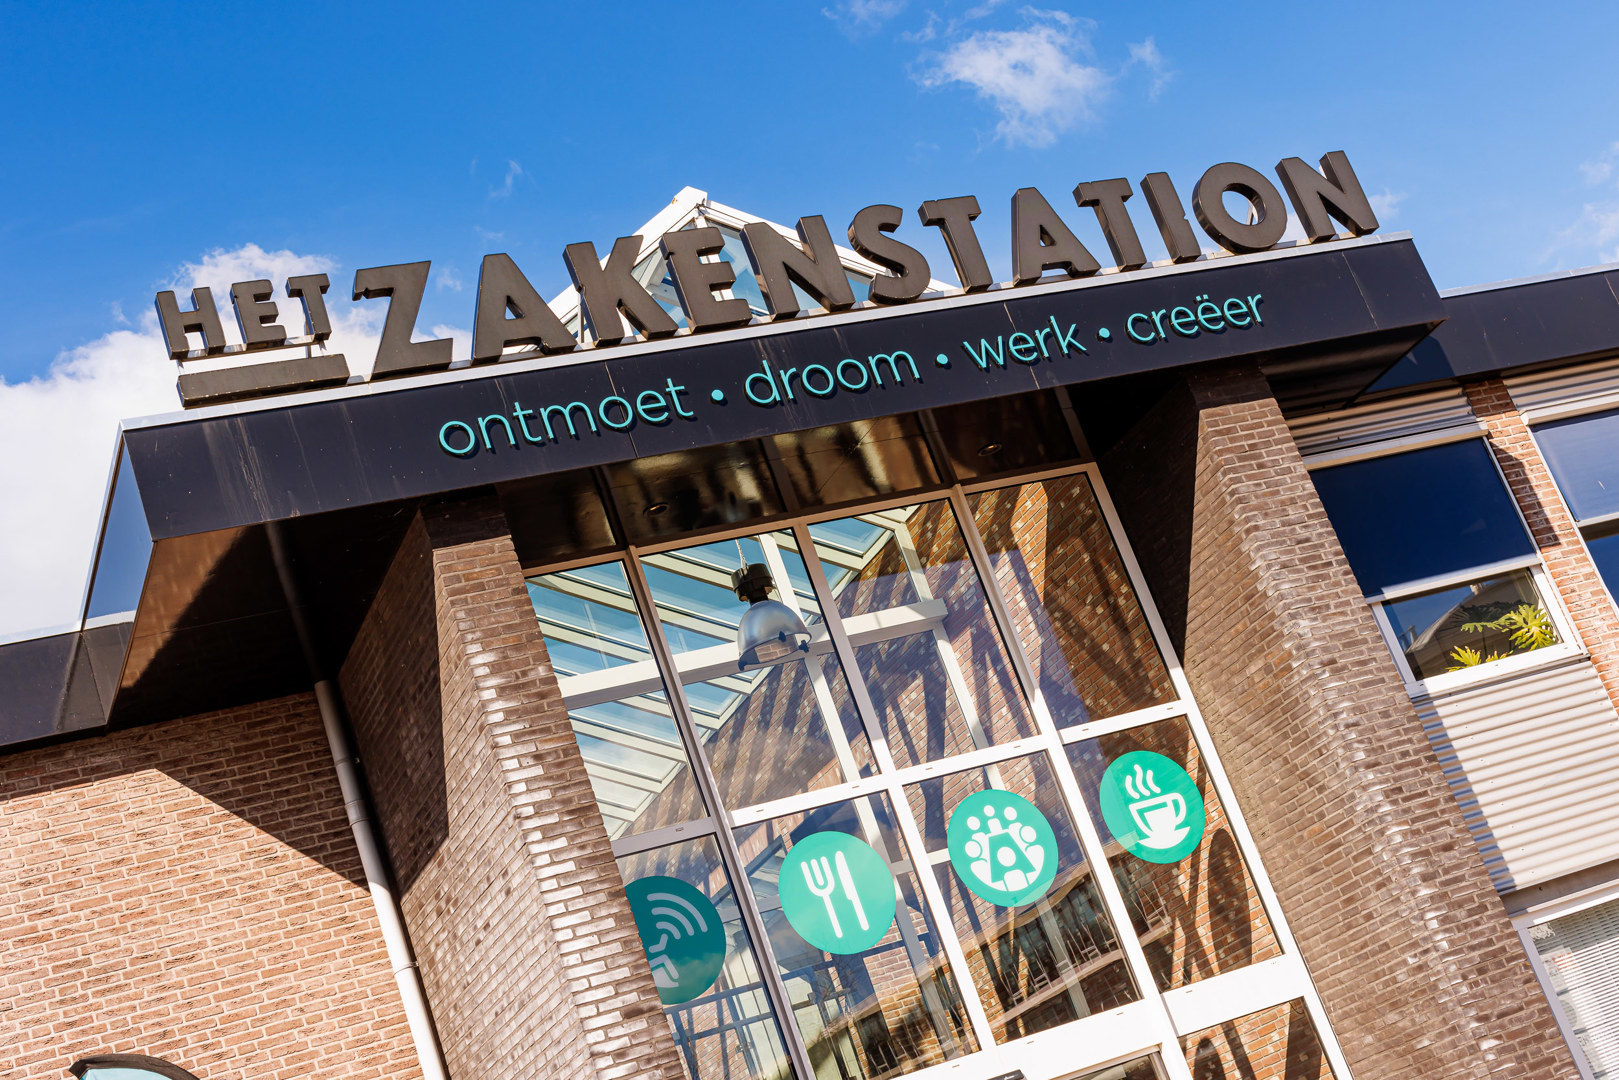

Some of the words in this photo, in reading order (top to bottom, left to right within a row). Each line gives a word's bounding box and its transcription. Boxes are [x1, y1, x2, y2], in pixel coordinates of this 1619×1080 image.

[155, 273, 332, 360] HET
[352, 151, 1379, 383] ZAKENSTATION
[438, 377, 695, 457] ontmoet
[744, 350, 921, 405] droom
[962, 315, 1088, 370] werk
[1126, 293, 1263, 343] creëer
